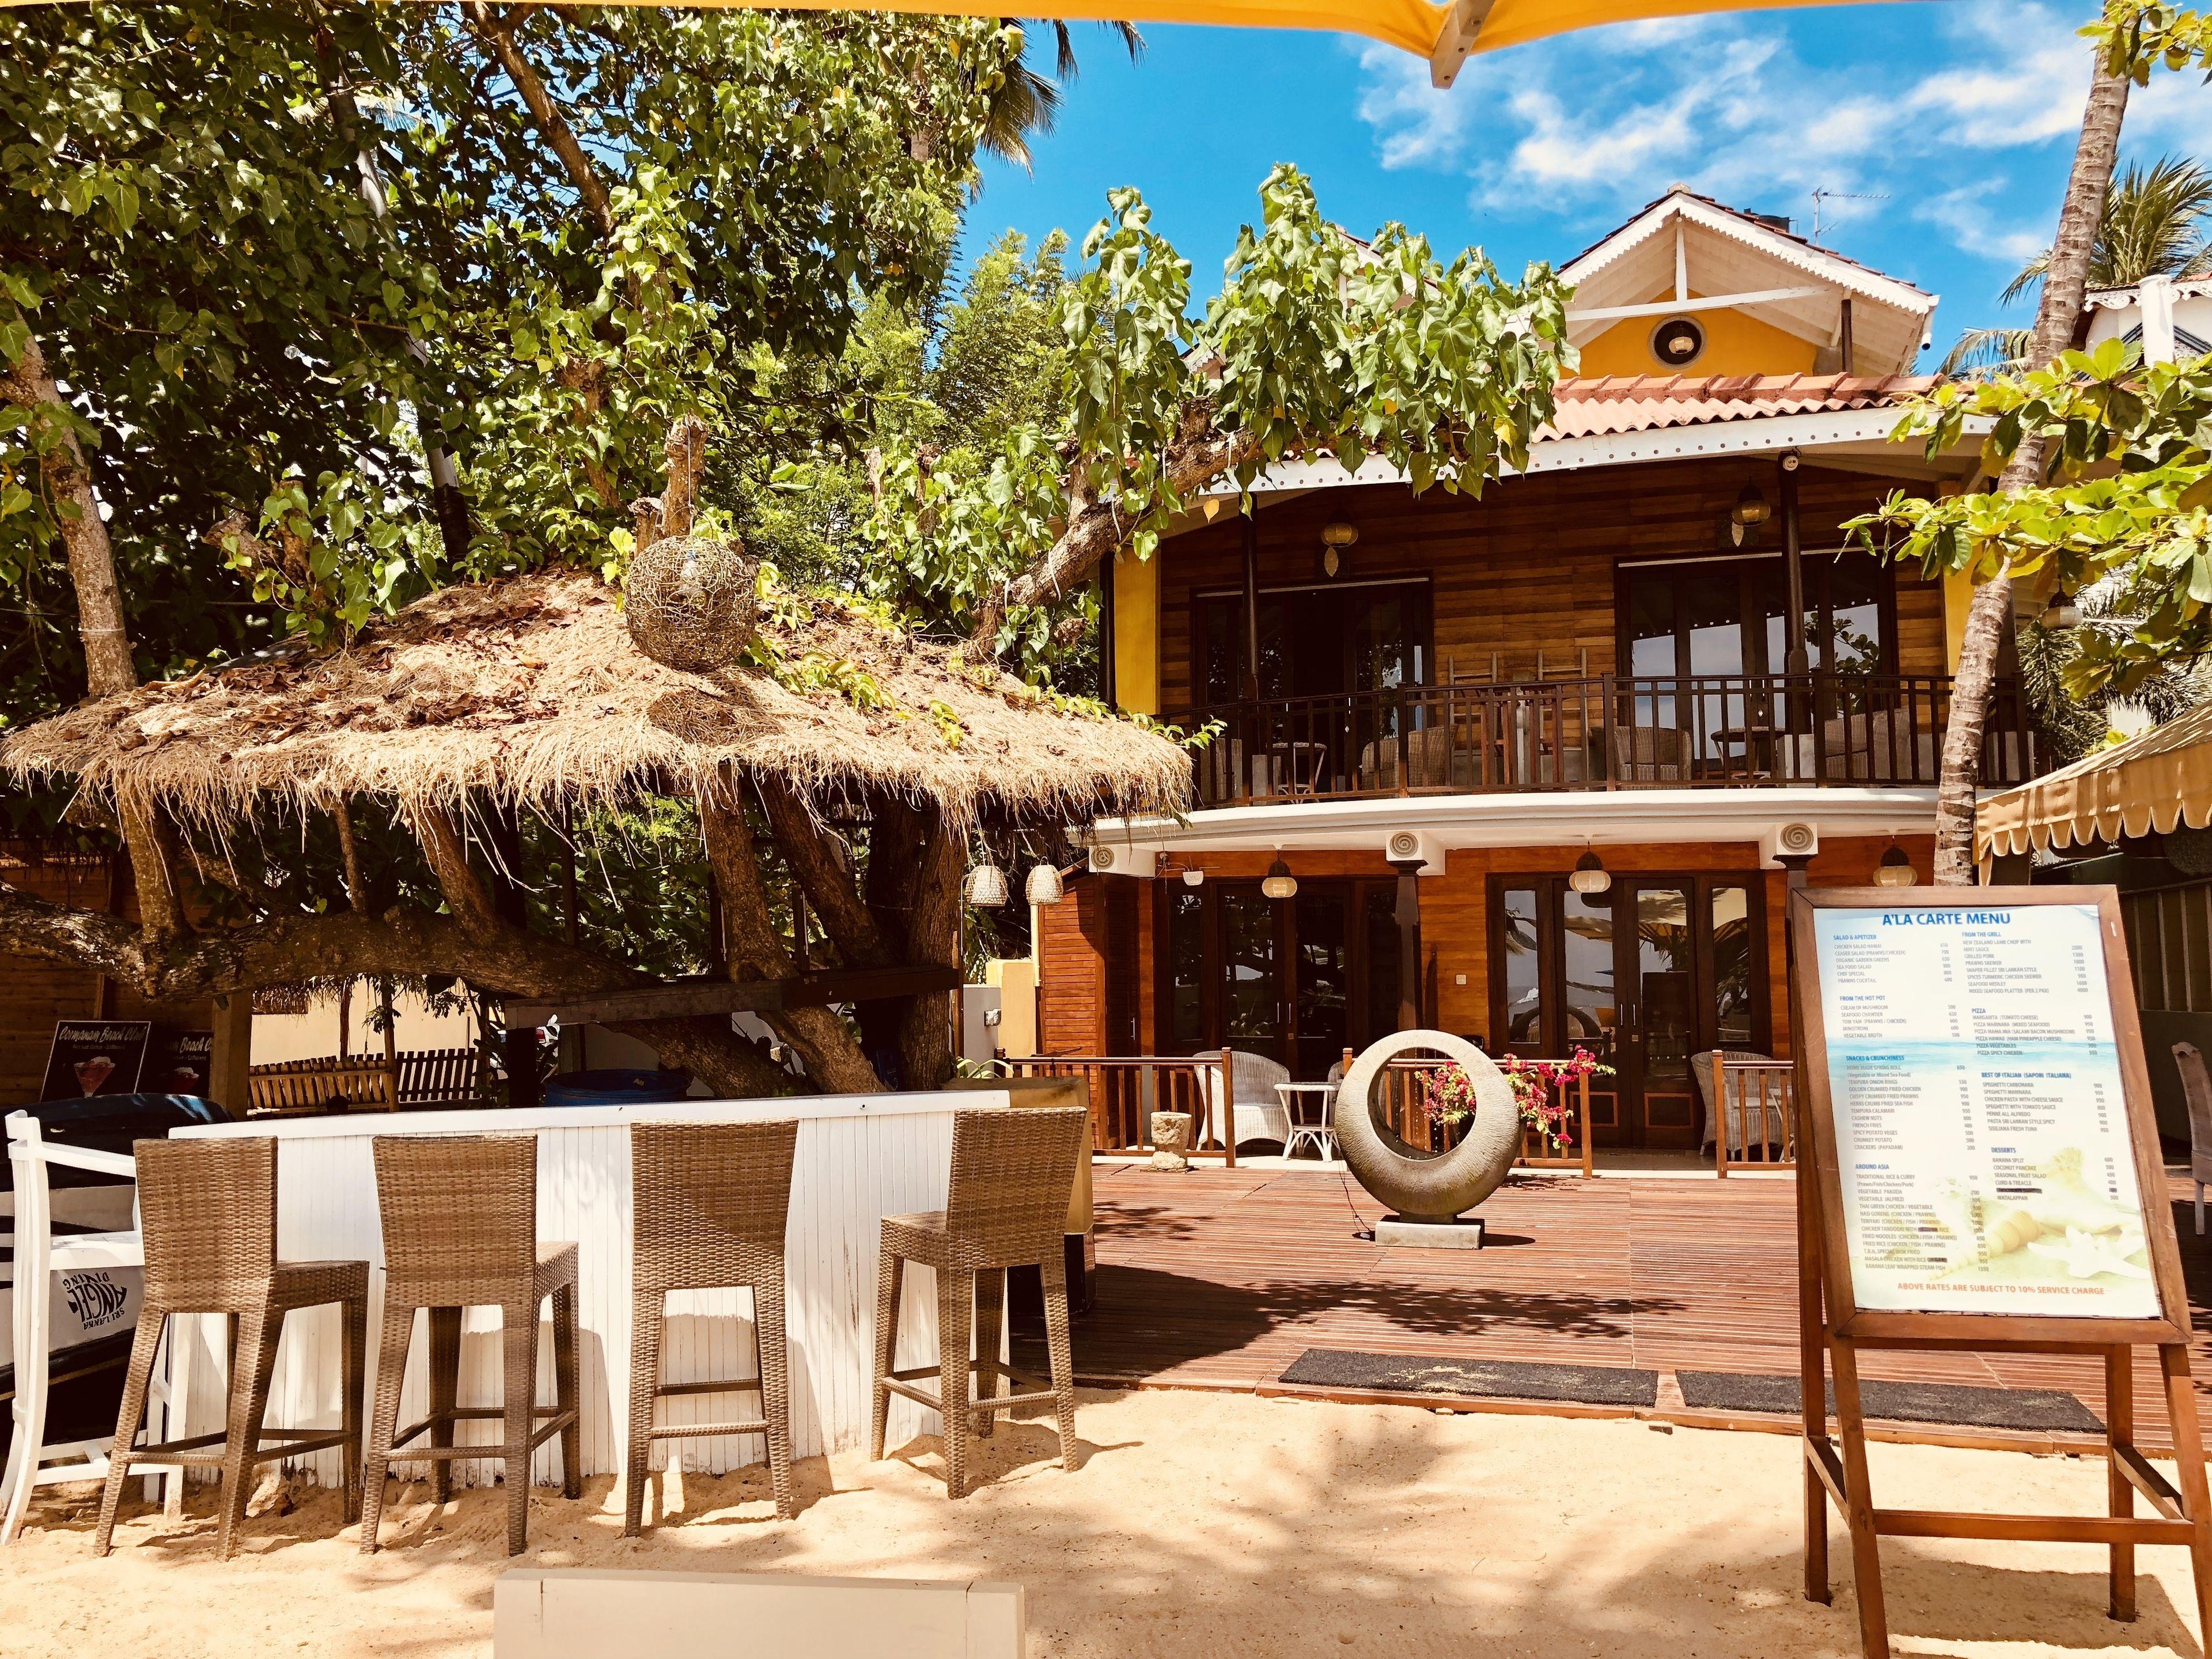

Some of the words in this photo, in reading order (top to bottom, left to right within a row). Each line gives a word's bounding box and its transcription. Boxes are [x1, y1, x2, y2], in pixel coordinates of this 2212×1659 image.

[1883, 914, 1913, 925] A'LA
[1916, 913, 1963, 925] CARTE
[1966, 913, 2010, 924] MENU
[180, 1037, 204, 1053] Beach
[62, 1272, 110, 1289] DIVING
[67, 1283, 127, 1322] ANGEL
[112, 1307, 125, 1321] SRI
[83, 1316, 110, 1330] LANKA
